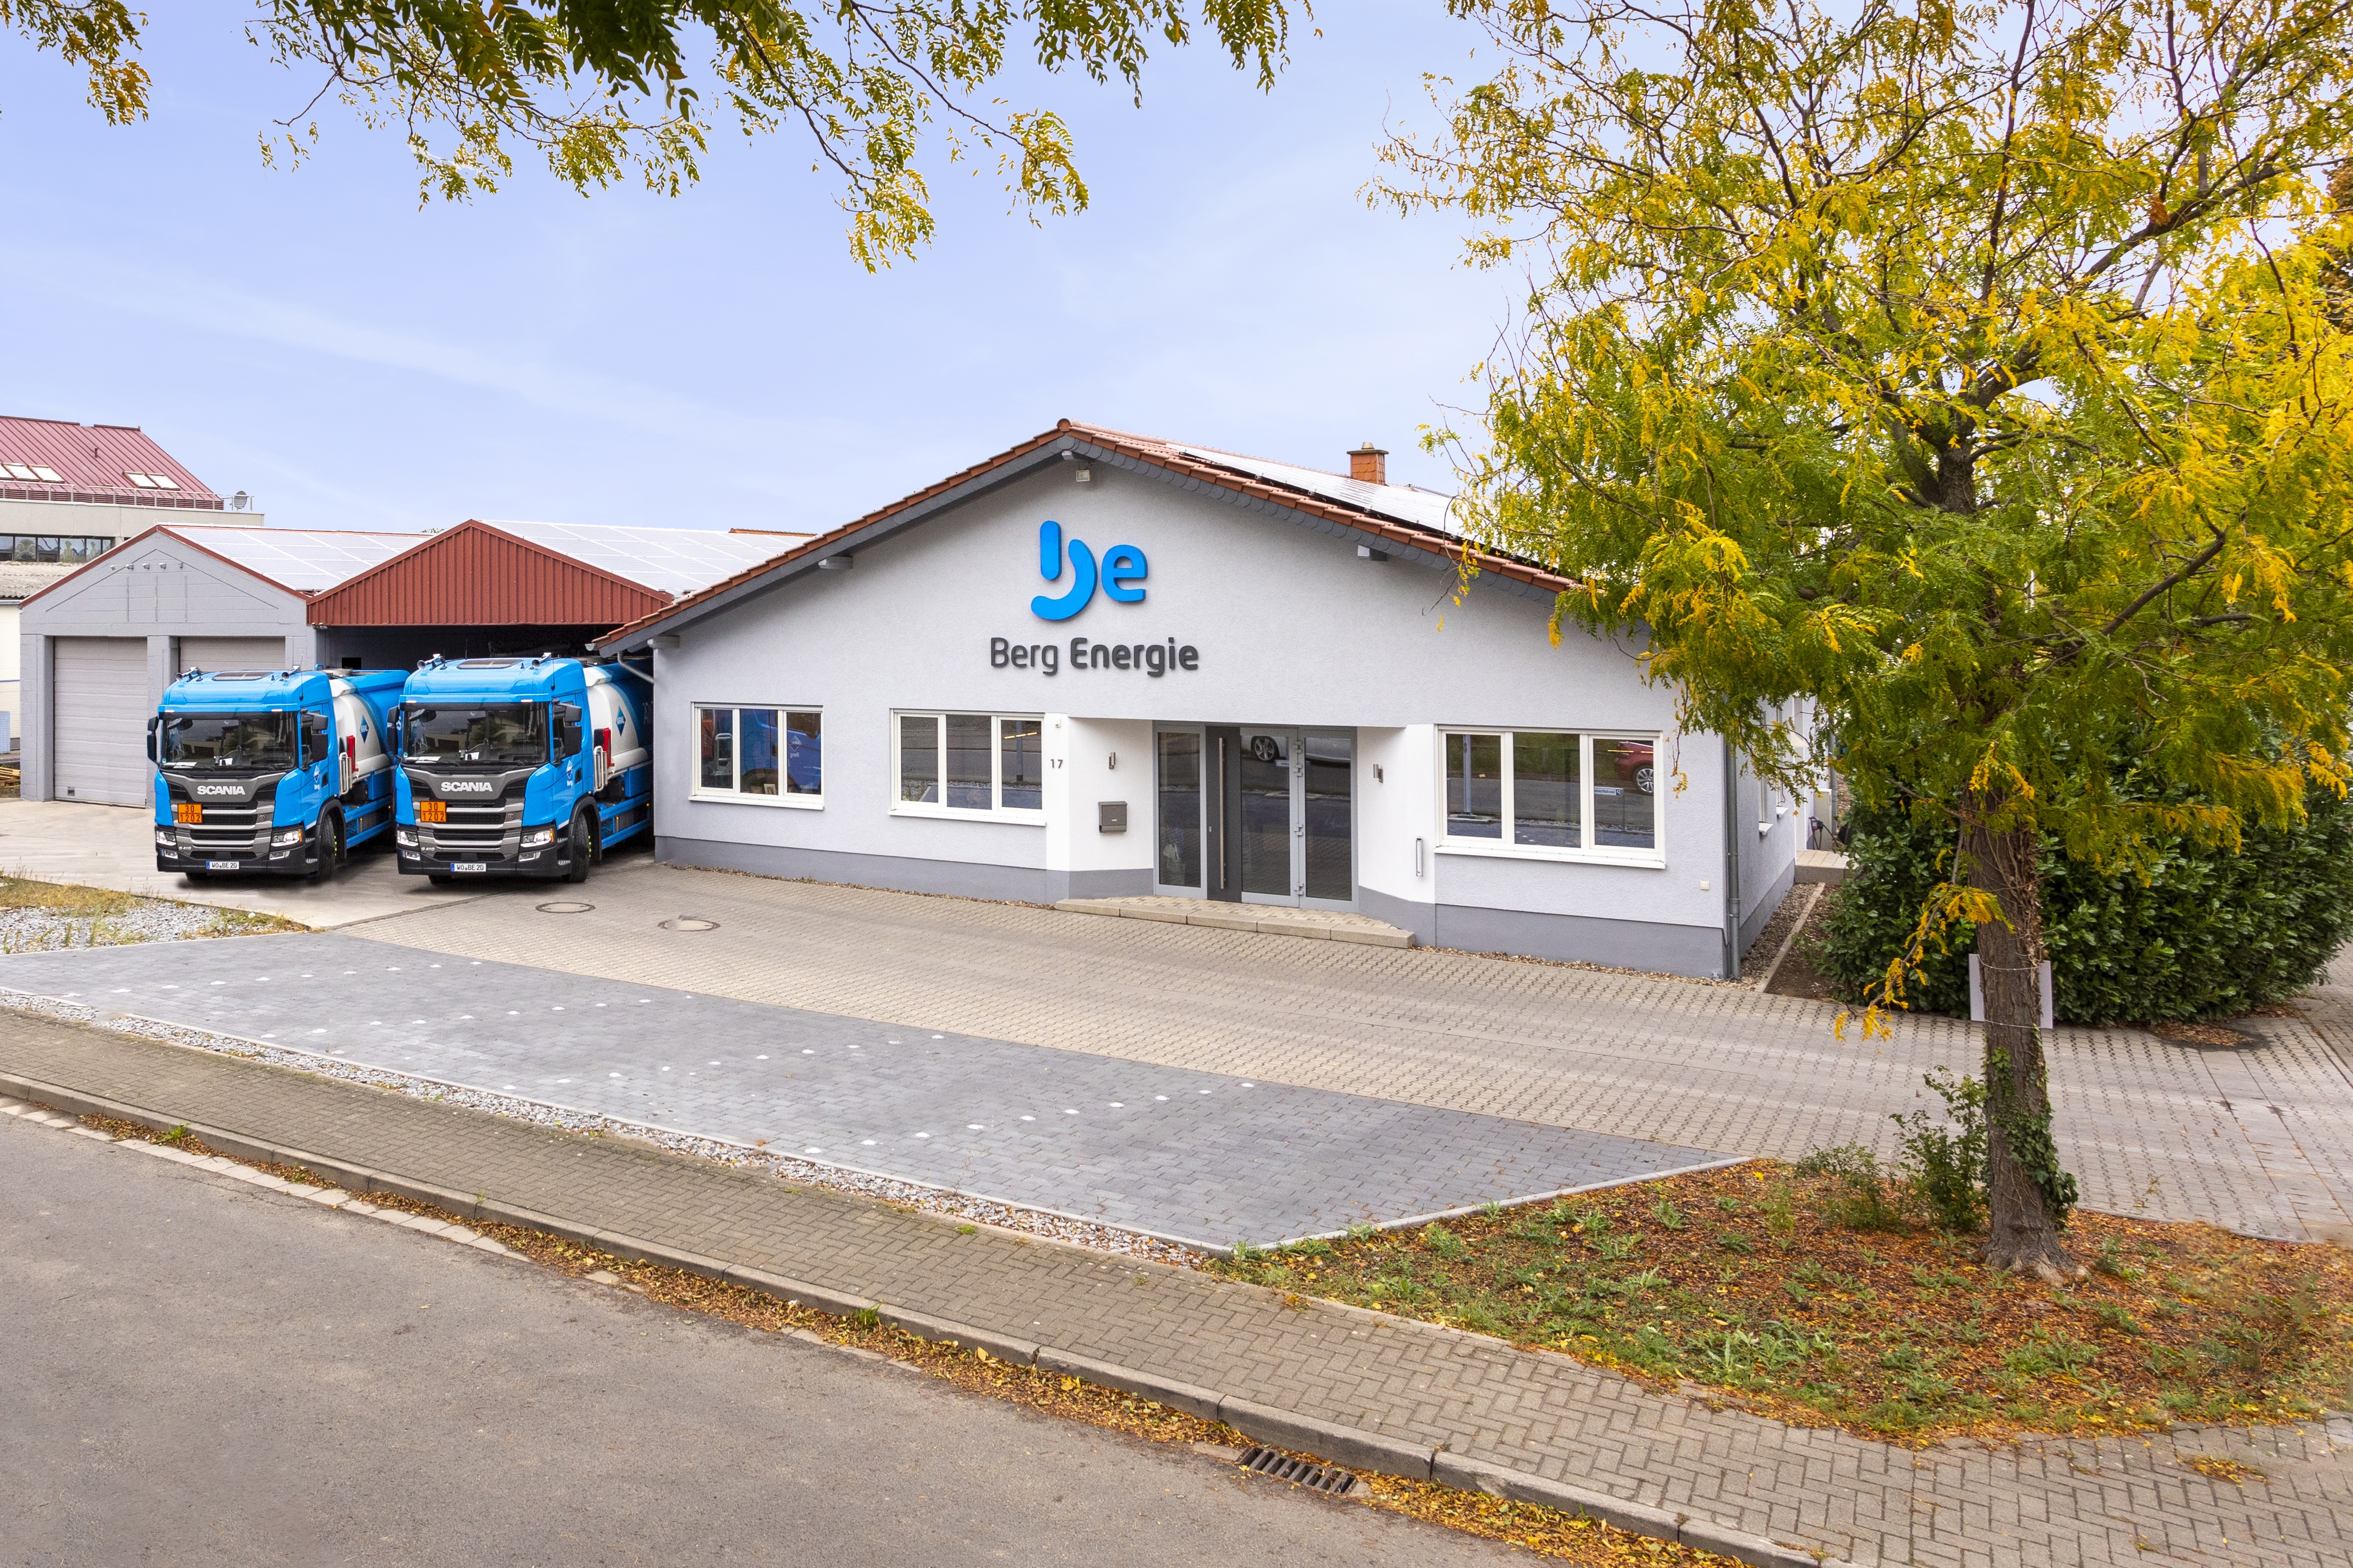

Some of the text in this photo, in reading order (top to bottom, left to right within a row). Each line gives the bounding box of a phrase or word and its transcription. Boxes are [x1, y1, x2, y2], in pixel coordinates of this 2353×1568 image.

[990, 637, 1199, 678] Berg Energie
[1050, 759, 1063, 769] 17
[197, 785, 245, 795] SCANIA
[441, 782, 493, 792] SCANIA
[185, 805, 194, 813] 30
[428, 803, 438, 811] 30
[180, 814, 200, 822] 1202
[422, 812, 444, 821] 1202
